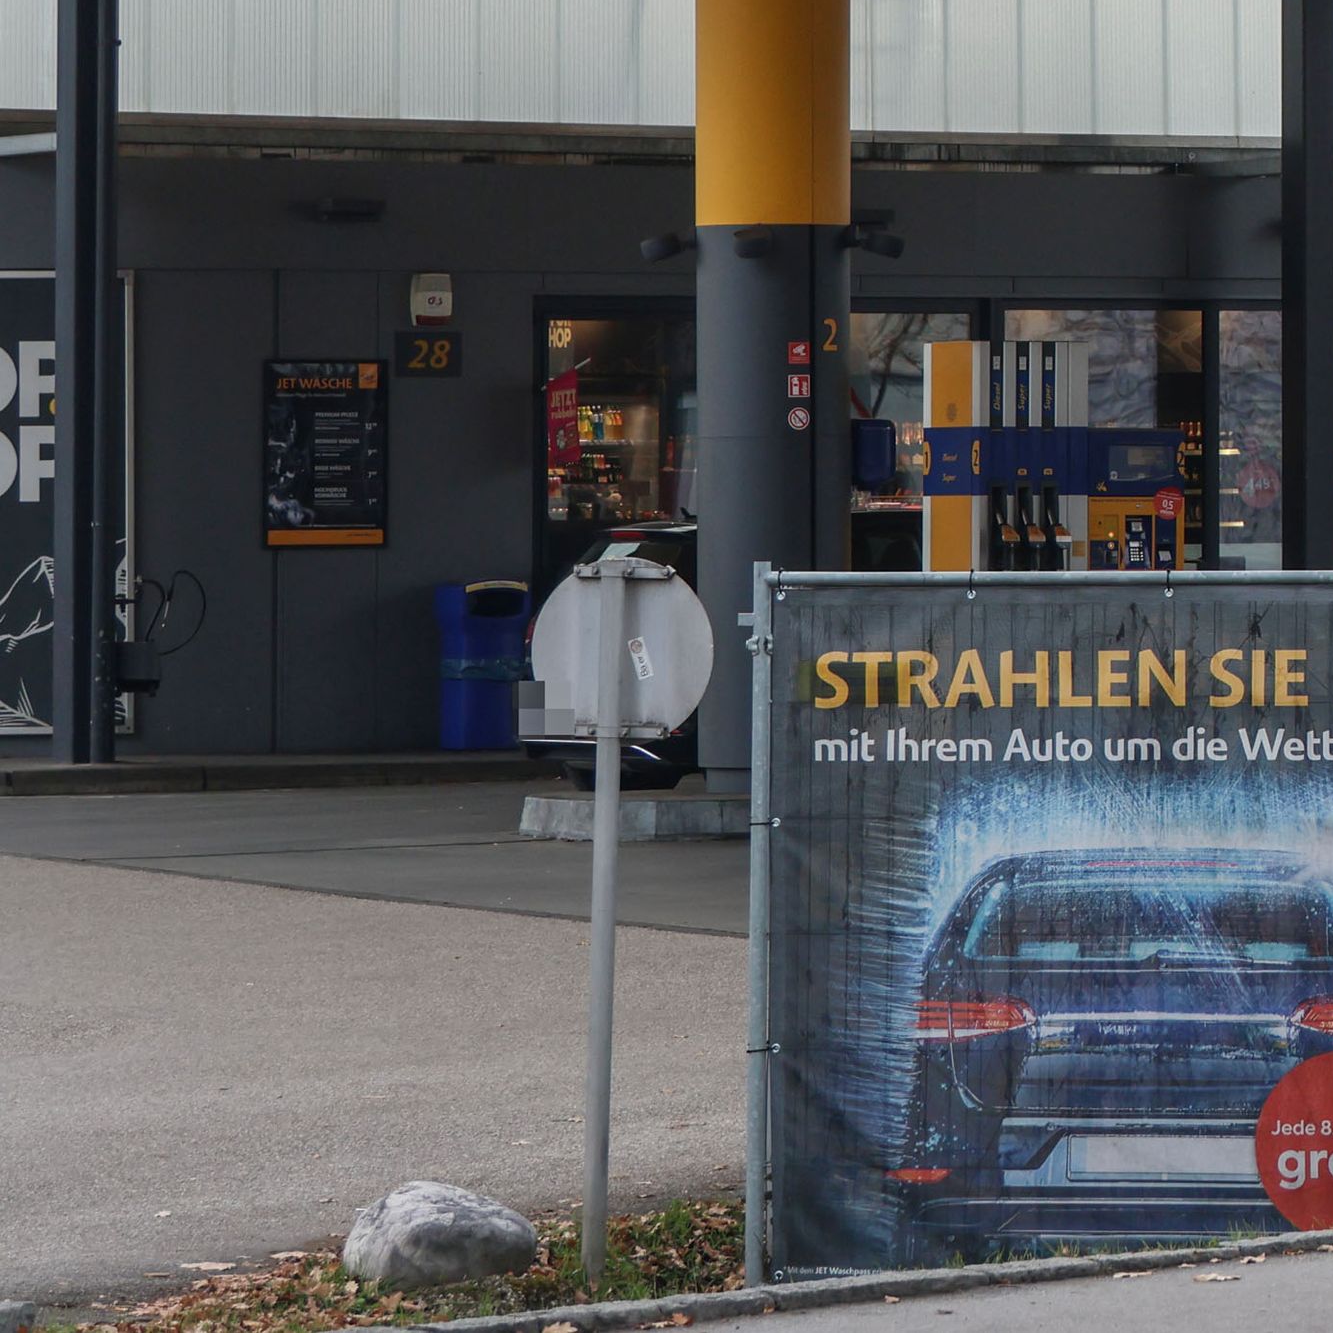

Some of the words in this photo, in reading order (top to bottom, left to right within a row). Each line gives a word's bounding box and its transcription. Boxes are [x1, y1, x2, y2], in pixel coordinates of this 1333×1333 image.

[822, 317, 838, 352] 2
[406, 339, 452, 369] 28
[276, 378, 296, 390] JET
[814, 648, 1187, 710] STRAHLEN
[1209, 648, 1310, 710] SIE
[814, 729, 875, 762] mit
[886, 727, 993, 763] Ihrem
[1002, 728, 1093, 763] Auto
[1104, 736, 1175, 763] um
[1179, 726, 1228, 762] die
[1271, 1120, 1316, 1137] Jede
[815, 1267, 828, 1275] JET
